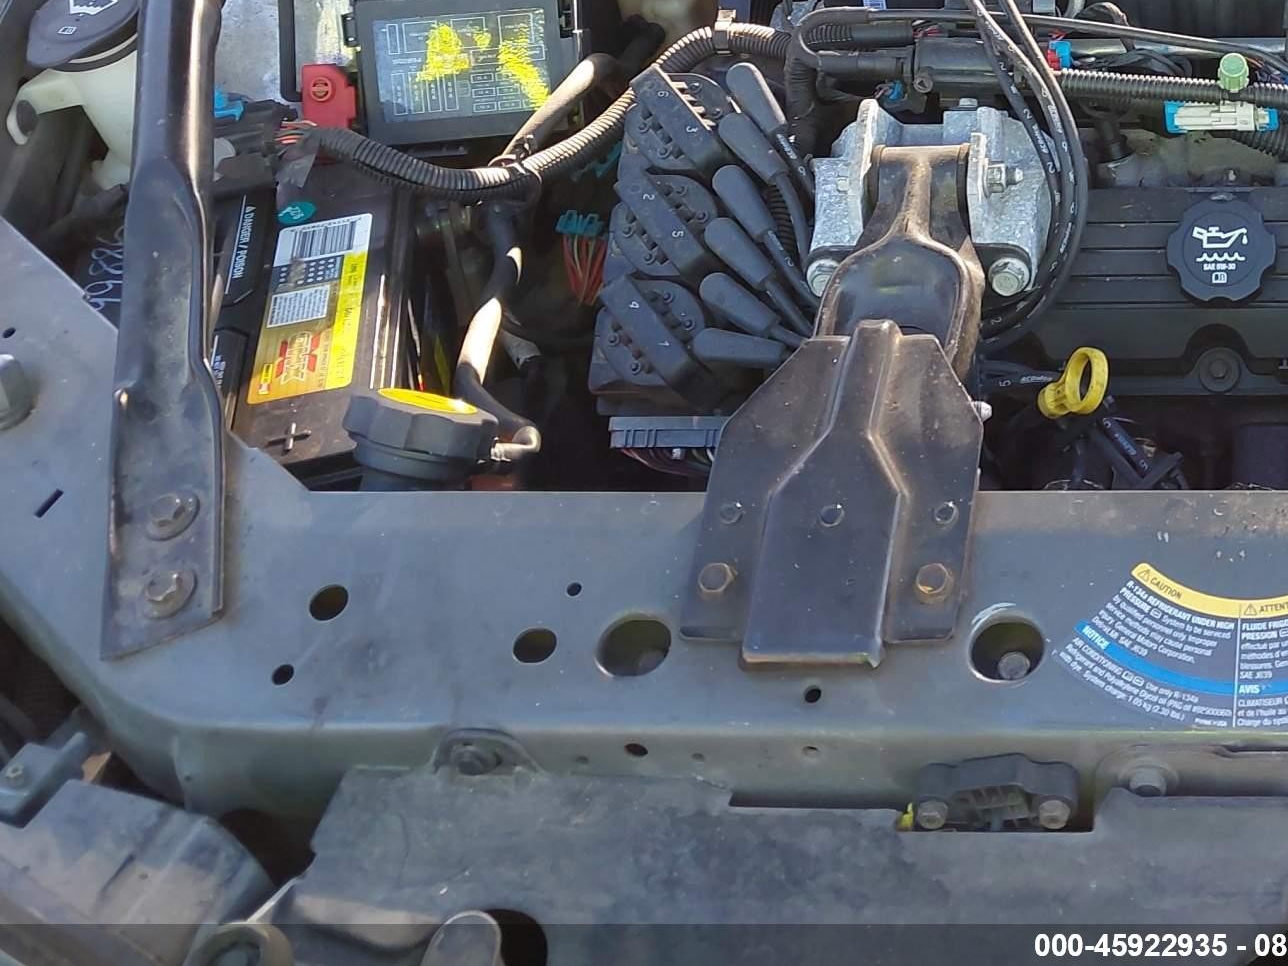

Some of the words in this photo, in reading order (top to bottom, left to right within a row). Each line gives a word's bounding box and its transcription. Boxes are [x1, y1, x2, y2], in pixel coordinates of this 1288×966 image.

[642, 193, 655, 201] 2
[238, 210, 255, 245] DANGER
[672, 229, 684, 238] 5
[231, 247, 248, 280] POISON
[1203, 263, 1216, 271] SAE
[1149, 576, 1182, 599] CAUTION
[1118, 586, 1152, 613] PRESSURE
[1161, 614, 1185, 630] System
[1193, 626, 1202, 634] be
[1202, 628, 1230, 638] serviced
[1125, 579, 1149, 599] R-134a
[1146, 595, 1191, 621] REFRIGERANT
[1191, 615, 1215, 627] UNDER
[1105, 602, 1126, 620] service
[1124, 616, 1150, 635] methods
[1149, 631, 1163, 642] may
[1163, 637, 1183, 648] cause
[1182, 644, 1212, 657] personal
[1111, 594, 1122, 605] by
[1118, 600, 1144, 621] qualified
[1142, 616, 1172, 635] personnel
[1187, 635, 1217, 648] Improper
[1242, 622, 1266, 630] FLUIDE
[1081, 624, 1110, 649] NOTICE
[1113, 620, 1137, 639] General
[1135, 634, 1158, 650] Motors
[1117, 635, 1132, 648] SAE
[1241, 630, 1277, 639] PRESSION
[1064, 643, 1094, 669] Refrigerant
[1092, 664, 1105, 676] and
[1138, 689, 1158, 703] Glycol
[1071, 636, 1084, 648] AIR
[1081, 643, 1123, 675] CONDITIONING
[1145, 681, 1158, 692] Use
[1158, 687, 1172, 698] only
[1173, 691, 1198, 703] R-134a
[1254, 670, 1272, 678] J639
[1082, 669, 1106, 689] System
[1141, 702, 1152, 712] kg
[1238, 684, 1260, 693] AVIS
[1238, 697, 1282, 706] CLIMATISEUR
